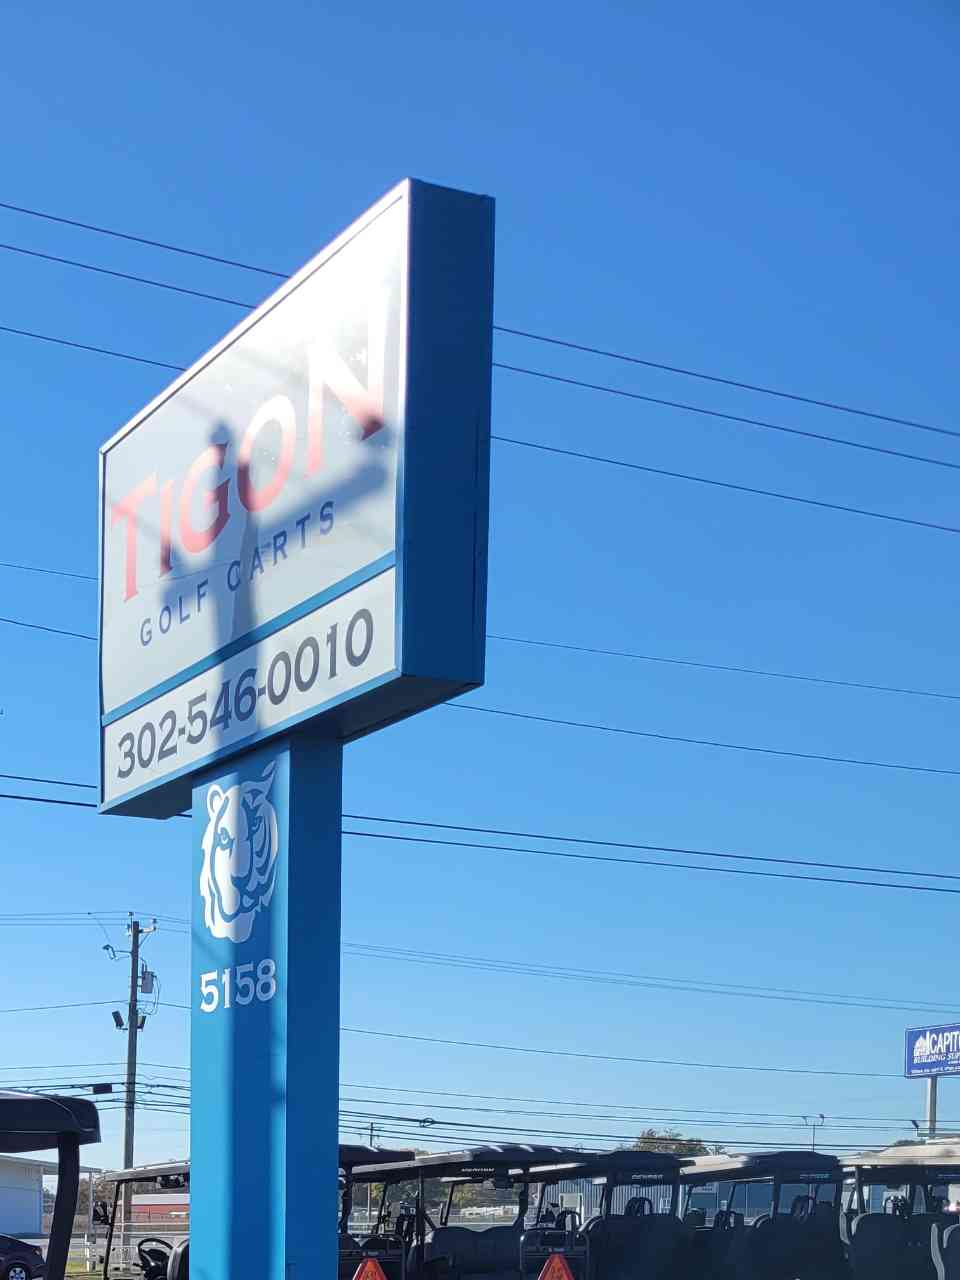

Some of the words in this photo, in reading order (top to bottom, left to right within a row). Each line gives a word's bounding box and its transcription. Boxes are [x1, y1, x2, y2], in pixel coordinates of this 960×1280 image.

[110, 292, 389, 603] TIGON
[140, 578, 209, 647] GOLF
[227, 500, 335, 592] CARTS
[117, 608, 374, 779] 302-546-0010
[200, 958, 276, 1012] 5158
[930, 1031, 960, 1053] CAPIT
